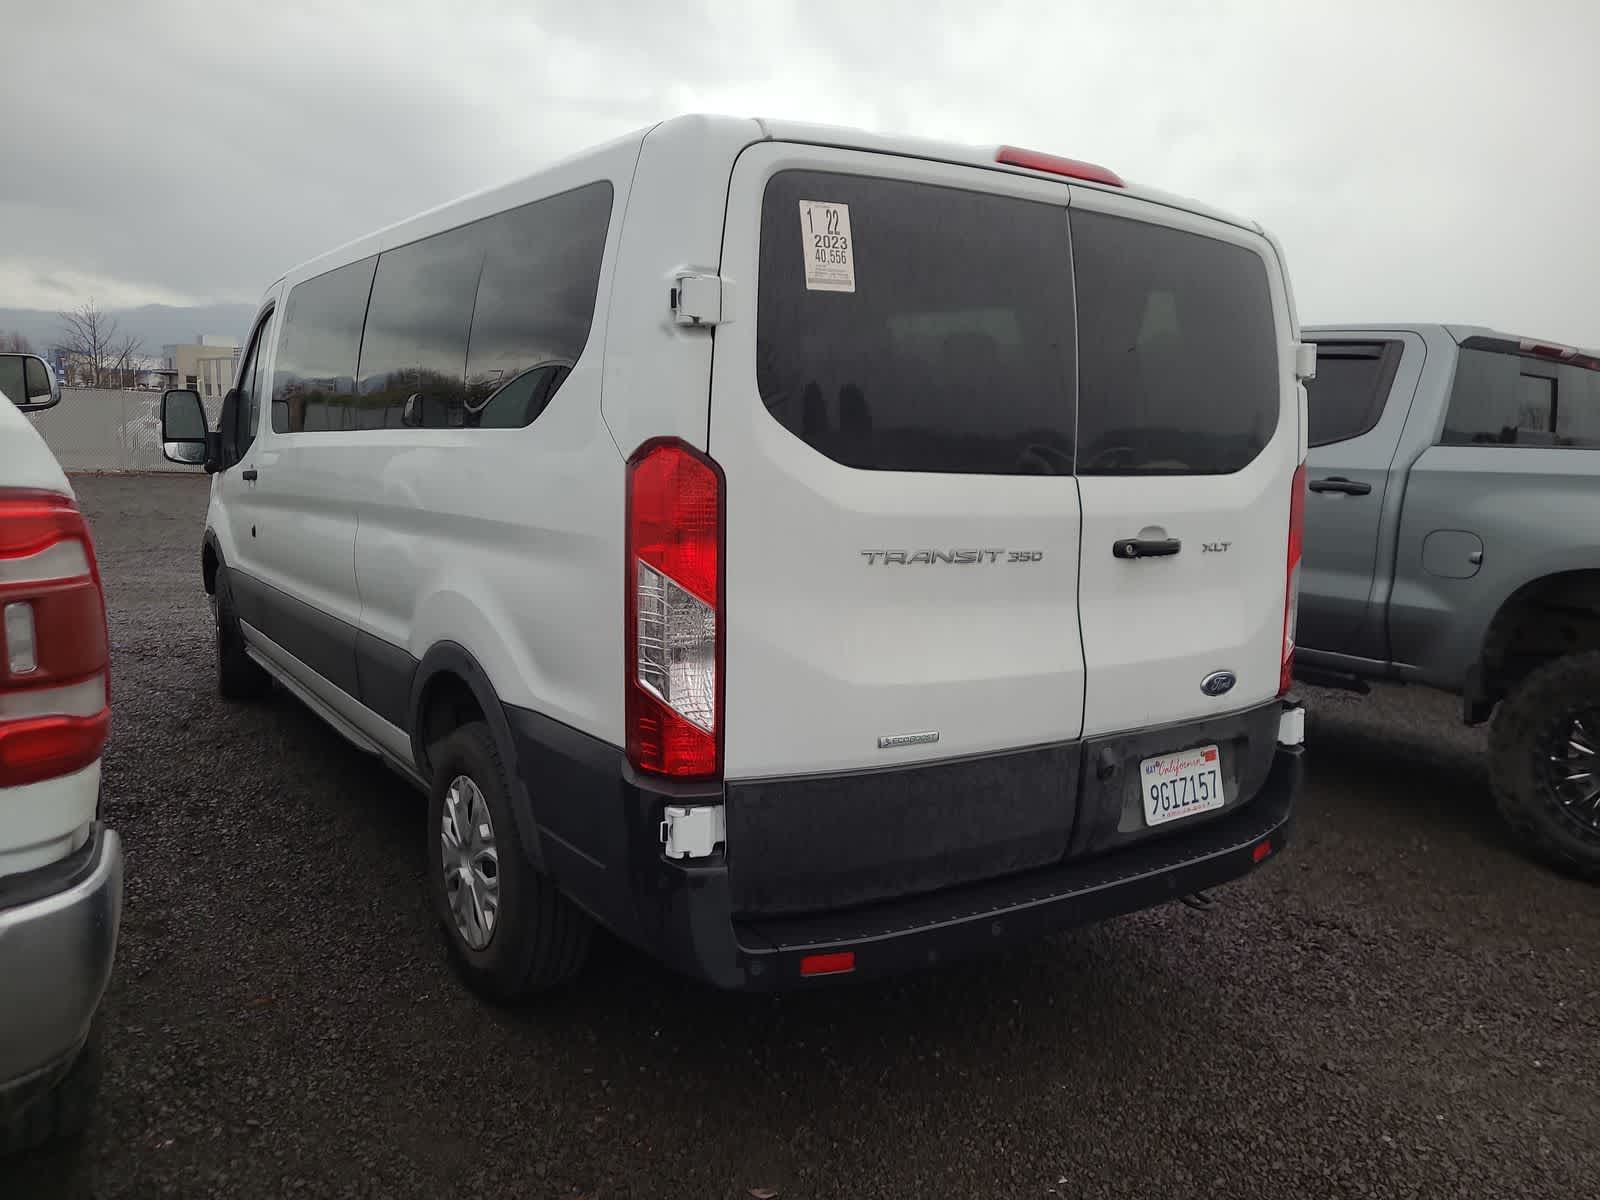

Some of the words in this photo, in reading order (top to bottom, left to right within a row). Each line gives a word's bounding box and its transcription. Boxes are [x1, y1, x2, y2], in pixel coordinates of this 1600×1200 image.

[806, 208, 813, 234] 1
[826, 209, 840, 235] 22
[814, 234, 848, 250] 2023
[815, 248, 847, 264] 40,556
[1202, 542, 1232, 552] XLT
[860, 549, 1005, 566] TRANSIT
[1007, 551, 1044, 563] 350
[1158, 758, 1205, 776] California
[1150, 770, 1217, 815] 9GIZ157
